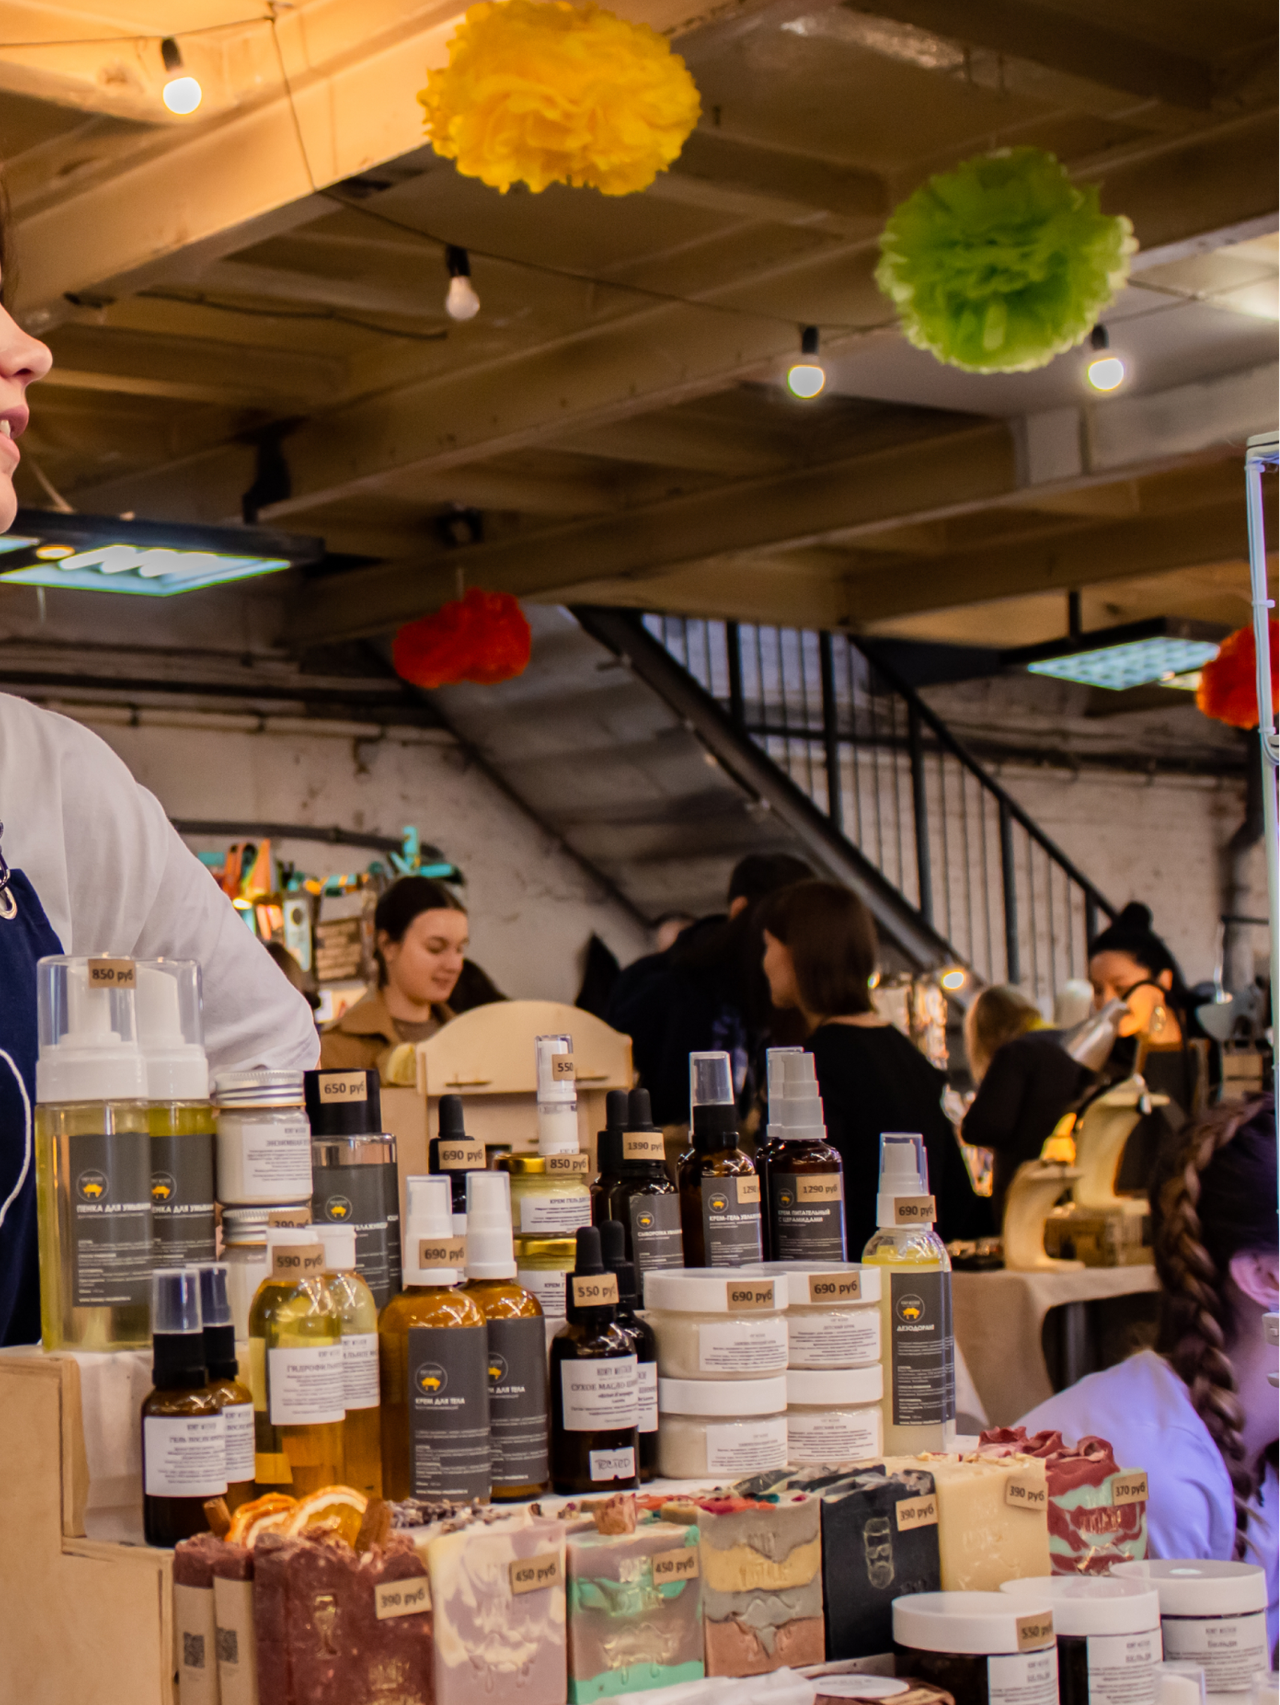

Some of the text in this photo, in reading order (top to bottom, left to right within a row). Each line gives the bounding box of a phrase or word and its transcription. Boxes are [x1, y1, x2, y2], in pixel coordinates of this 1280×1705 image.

[92, 968, 114, 980] 850
[324, 1083, 346, 1094] 650
[627, 1142, 649, 1151] 1390
[442, 1150, 464, 1161] 690
[550, 1159, 570, 1169] 850
[803, 1185, 823, 1194] 1290
[898, 1206, 918, 1216] 690
[425, 1249, 447, 1260] 690
[276, 1256, 300, 1268] 590
[578, 1286, 599, 1297] 550
[814, 1280, 857, 1296] 690 руб
[732, 1289, 772, 1303] 690 руб
[1009, 1485, 1045, 1503] 390 руб
[1131, 1482, 1146, 1497] руб
[900, 1503, 934, 1521] 390 руб
